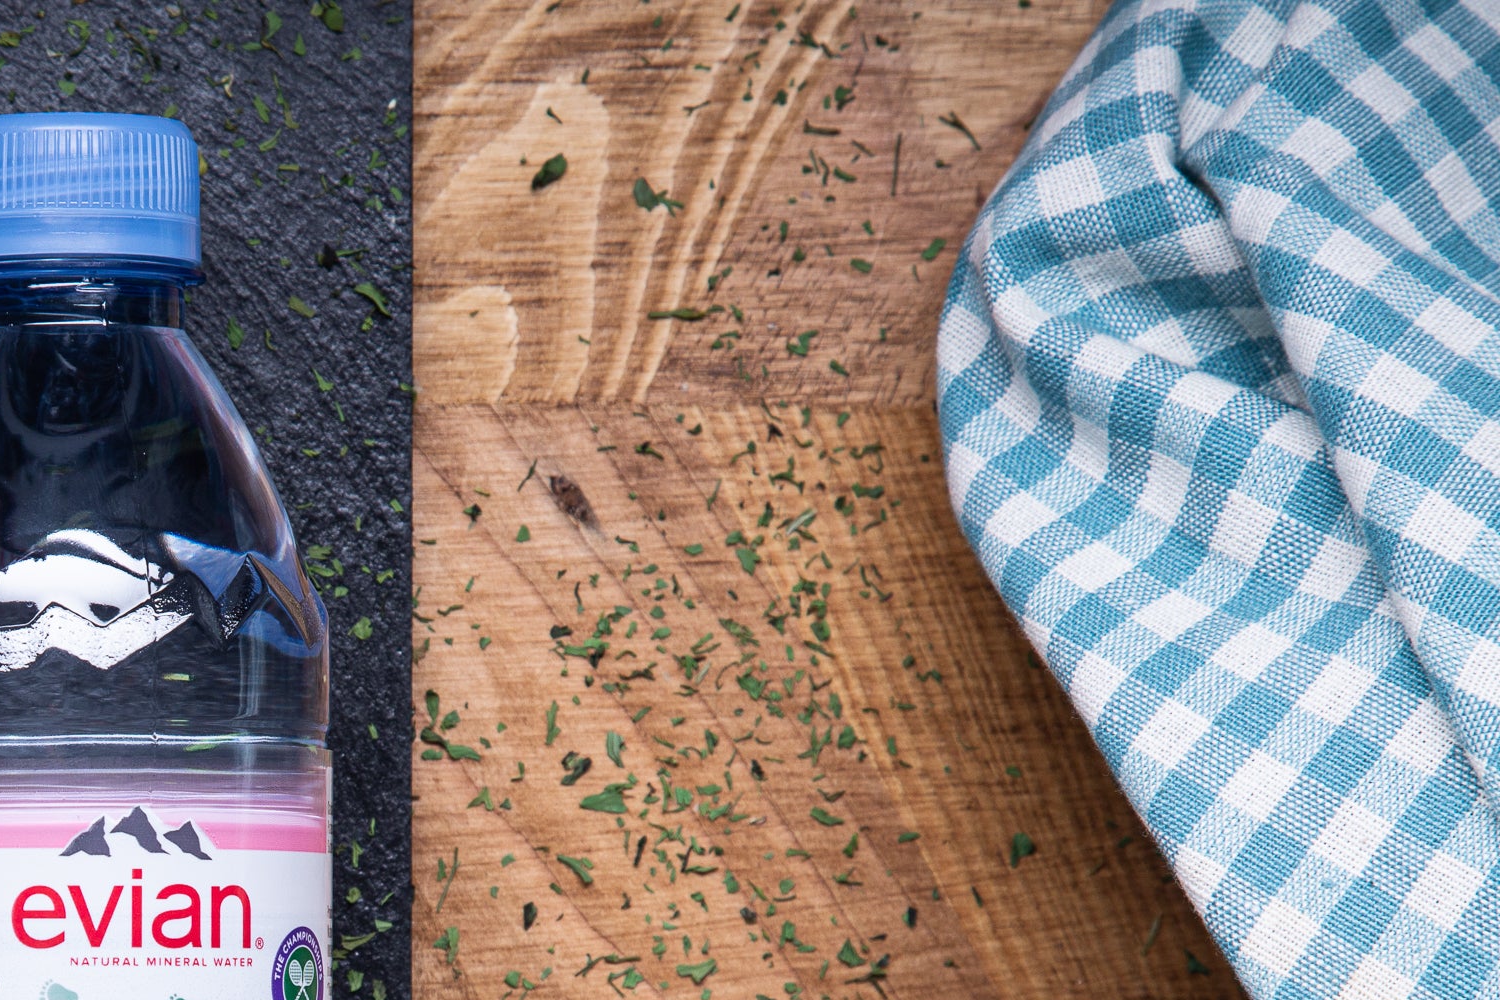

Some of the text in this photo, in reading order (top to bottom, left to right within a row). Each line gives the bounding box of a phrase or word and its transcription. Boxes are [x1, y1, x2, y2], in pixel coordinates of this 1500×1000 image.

[70, 957, 253, 967] NATURAL MINERAL WATER
[274, 931, 323, 981] THE CHAMPIONSHIPS
